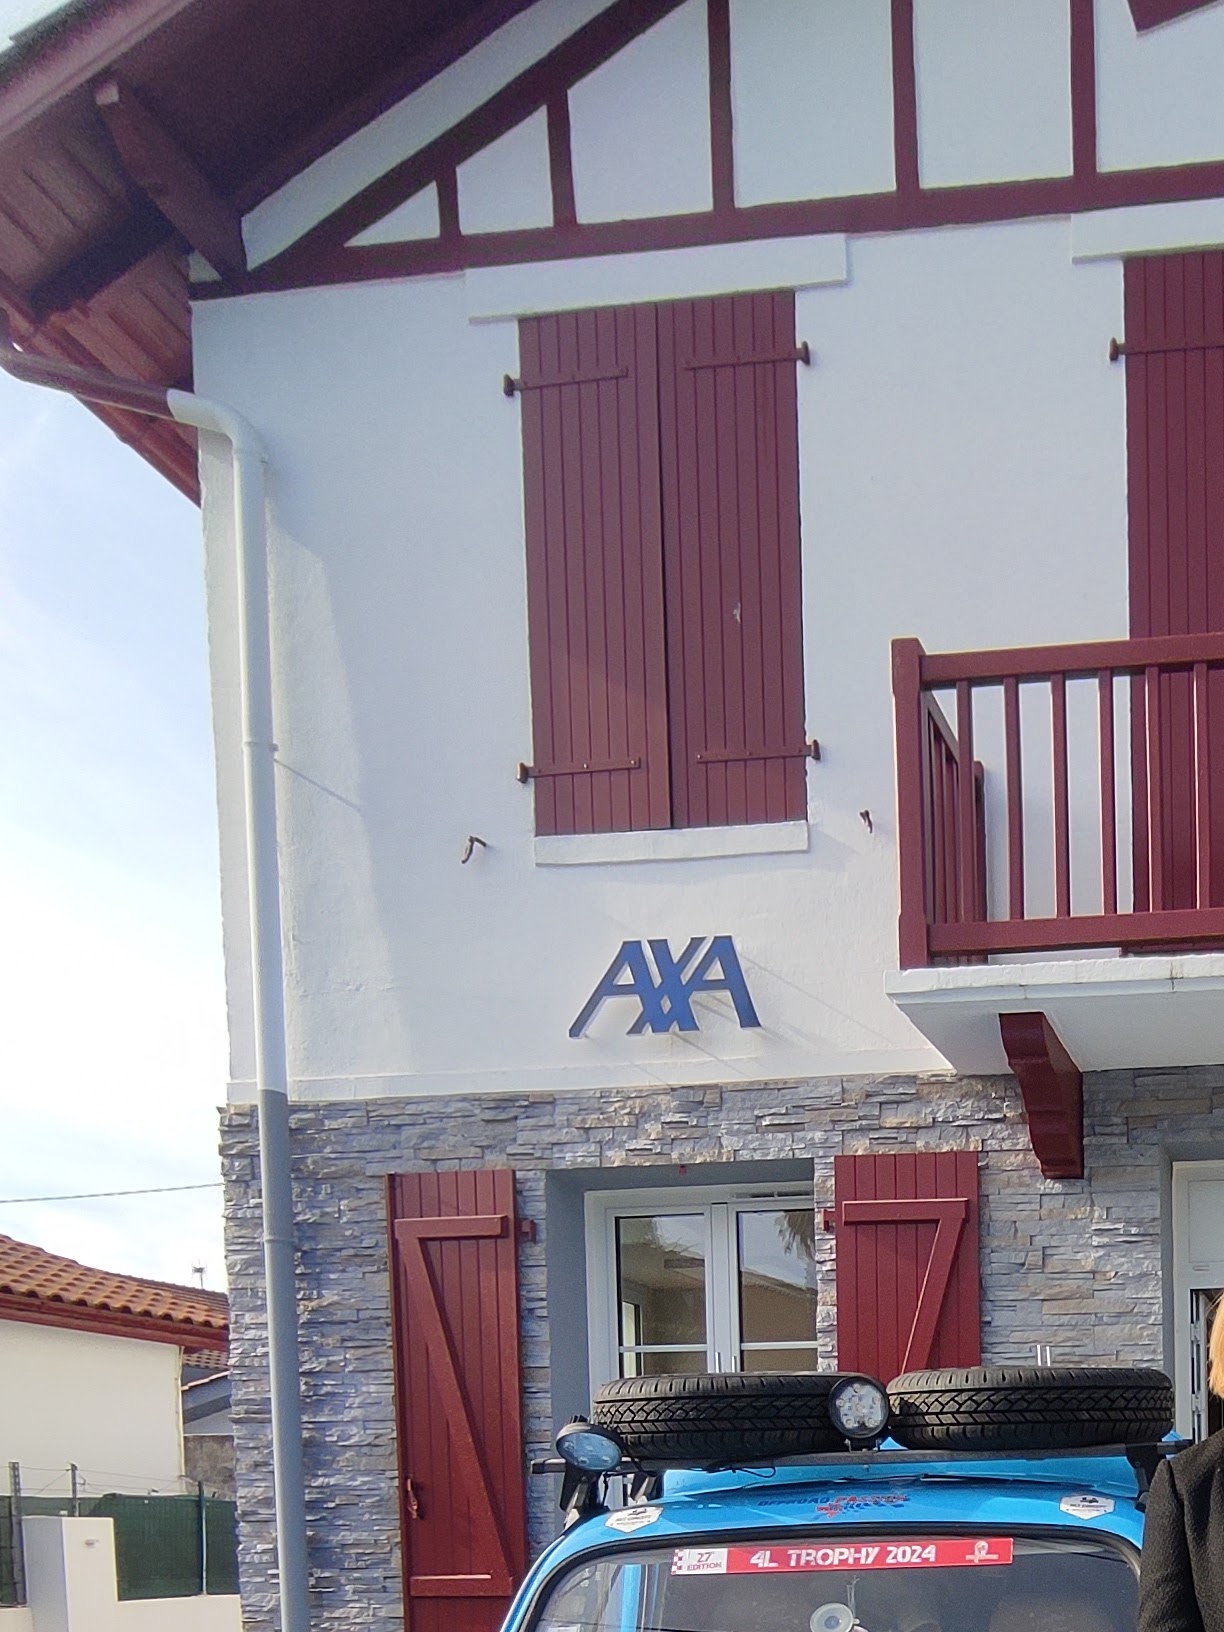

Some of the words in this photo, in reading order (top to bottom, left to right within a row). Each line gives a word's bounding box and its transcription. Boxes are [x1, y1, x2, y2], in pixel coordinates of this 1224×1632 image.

[568, 934, 762, 1039] AXA
[687, 1561, 722, 1572] EDITION
[750, 1550, 779, 1568] 4L
[788, 1546, 880, 1567] TROPHY
[886, 1544, 937, 1564] 2024
